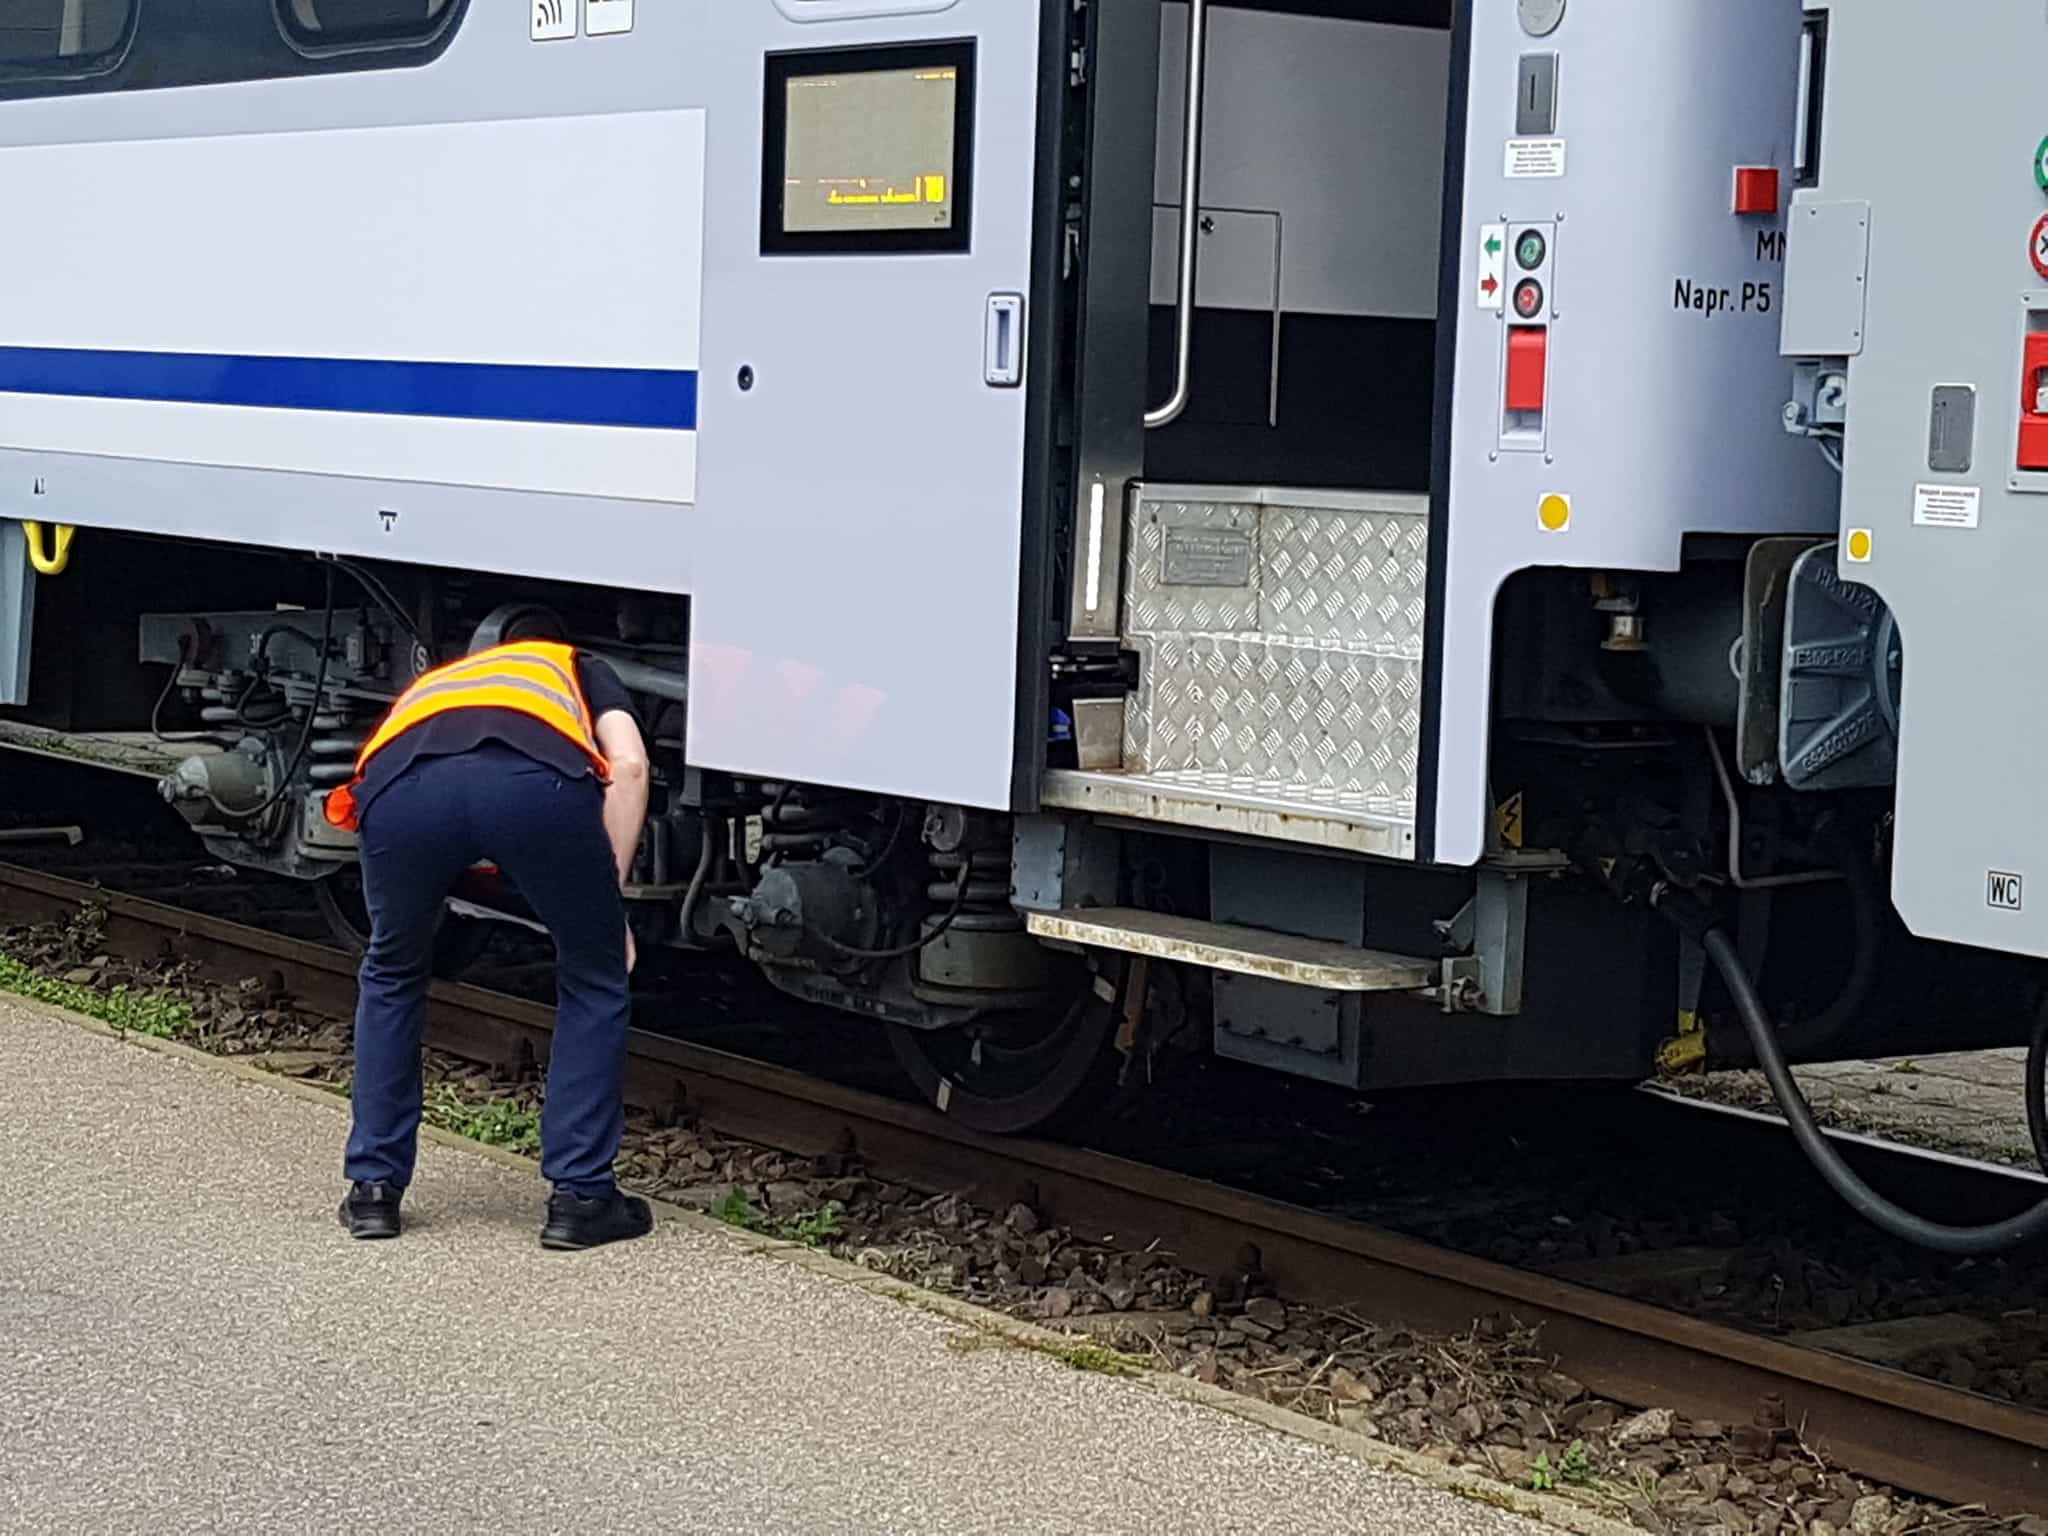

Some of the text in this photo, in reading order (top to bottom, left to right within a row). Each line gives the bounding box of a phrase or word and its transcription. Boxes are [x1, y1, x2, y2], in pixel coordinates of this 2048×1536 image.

[1674, 279, 1771, 319] Napr. P5
[415, 645, 428, 673] S
[1991, 876, 2018, 905] WC
